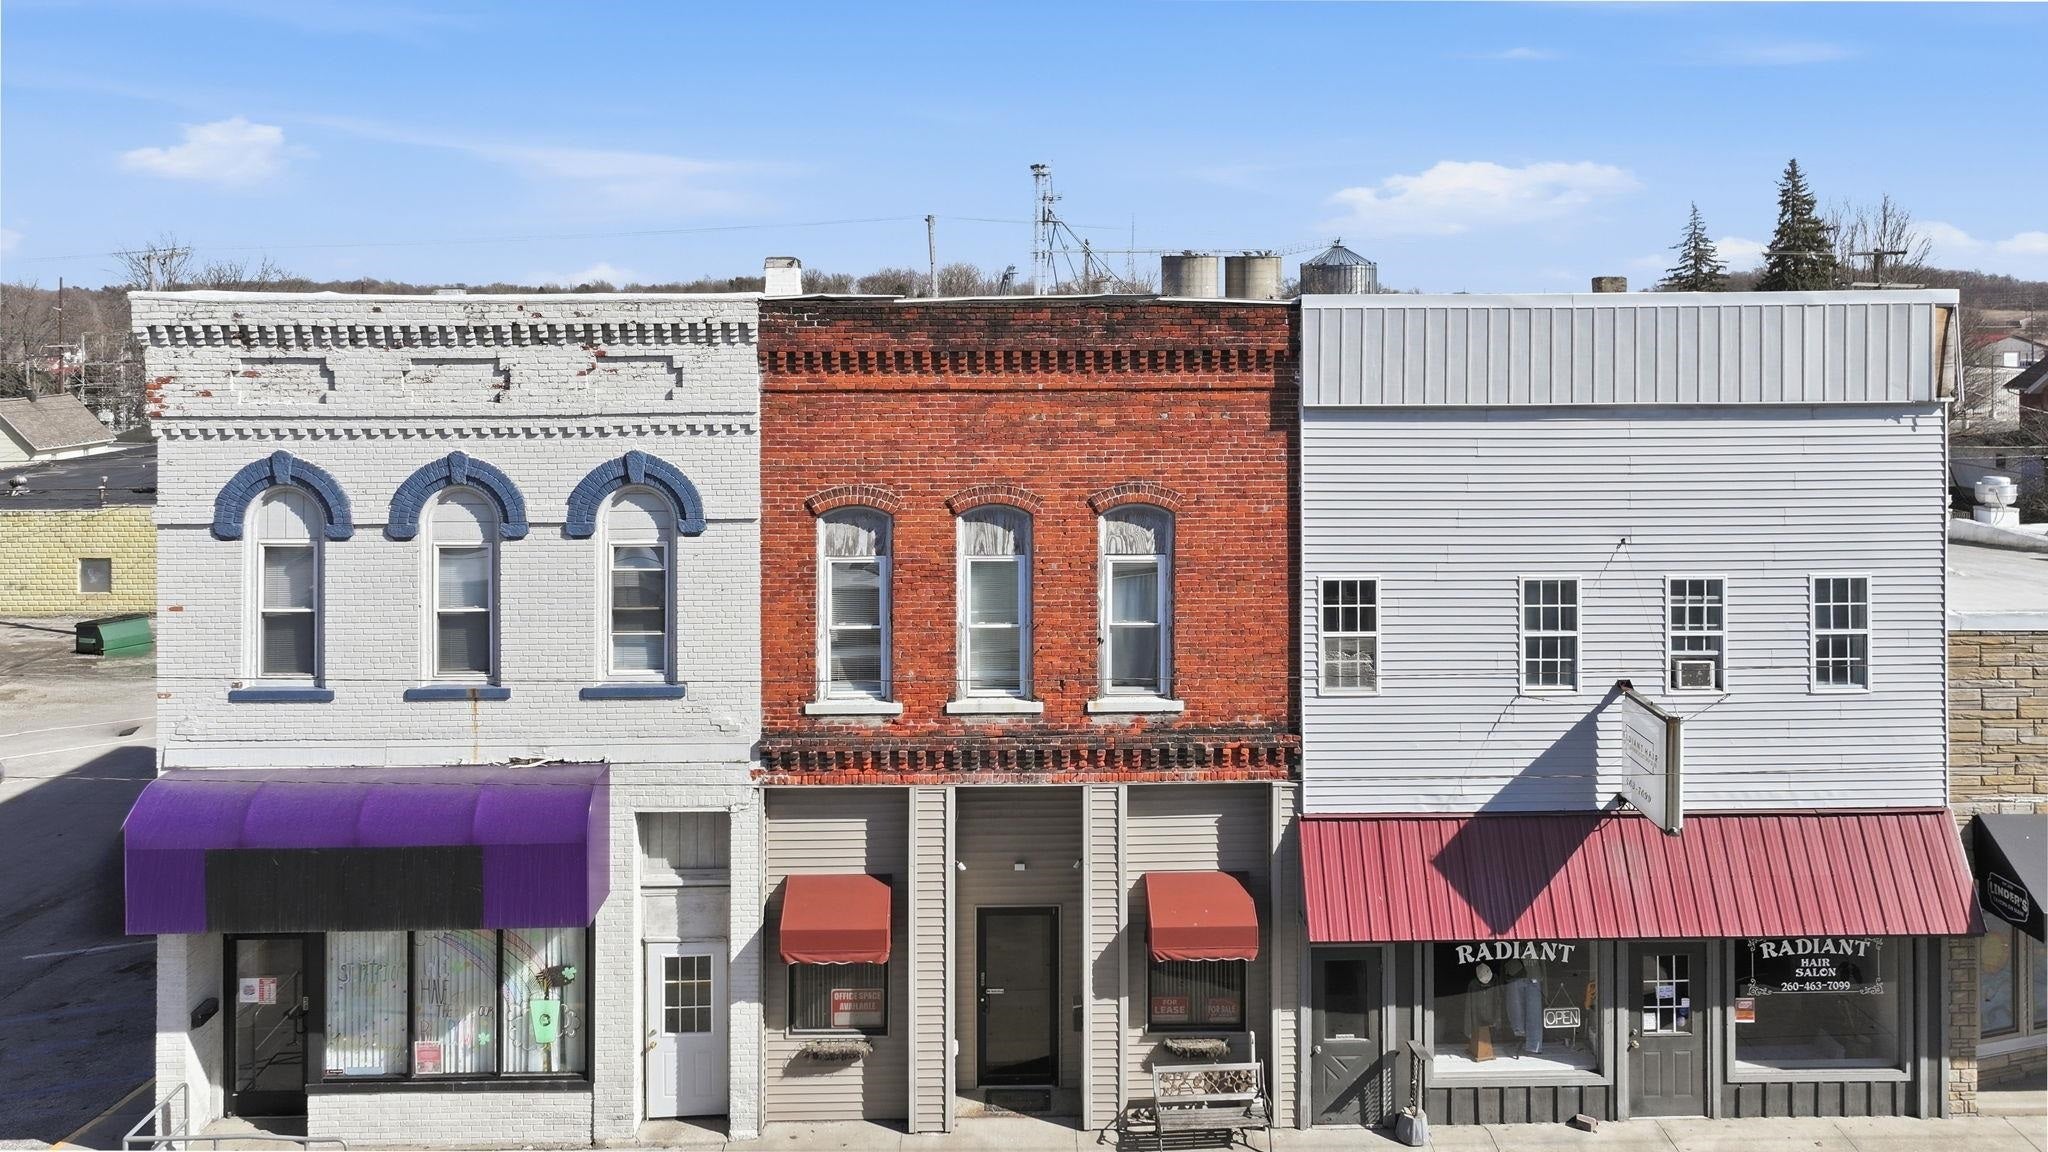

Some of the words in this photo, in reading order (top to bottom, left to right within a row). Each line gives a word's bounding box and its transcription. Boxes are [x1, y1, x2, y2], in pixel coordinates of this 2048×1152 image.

[1990, 881, 2028, 912] LINDER'S
[1455, 941, 1576, 965] RADIANT
[1760, 938, 1871, 959] RADIANT
[1801, 958, 1831, 967] HAIR
[1795, 967, 1837, 977] SALON
[1781, 981, 1851, 991] 260-463-7099
[834, 991, 857, 1000] OFFICE
[858, 991, 881, 1000] SPACE
[840, 1002, 876, 1011] AVAILABLE
[1154, 1006, 1186, 1014] LEASE
[1545, 1011, 1578, 1025] OPEN
